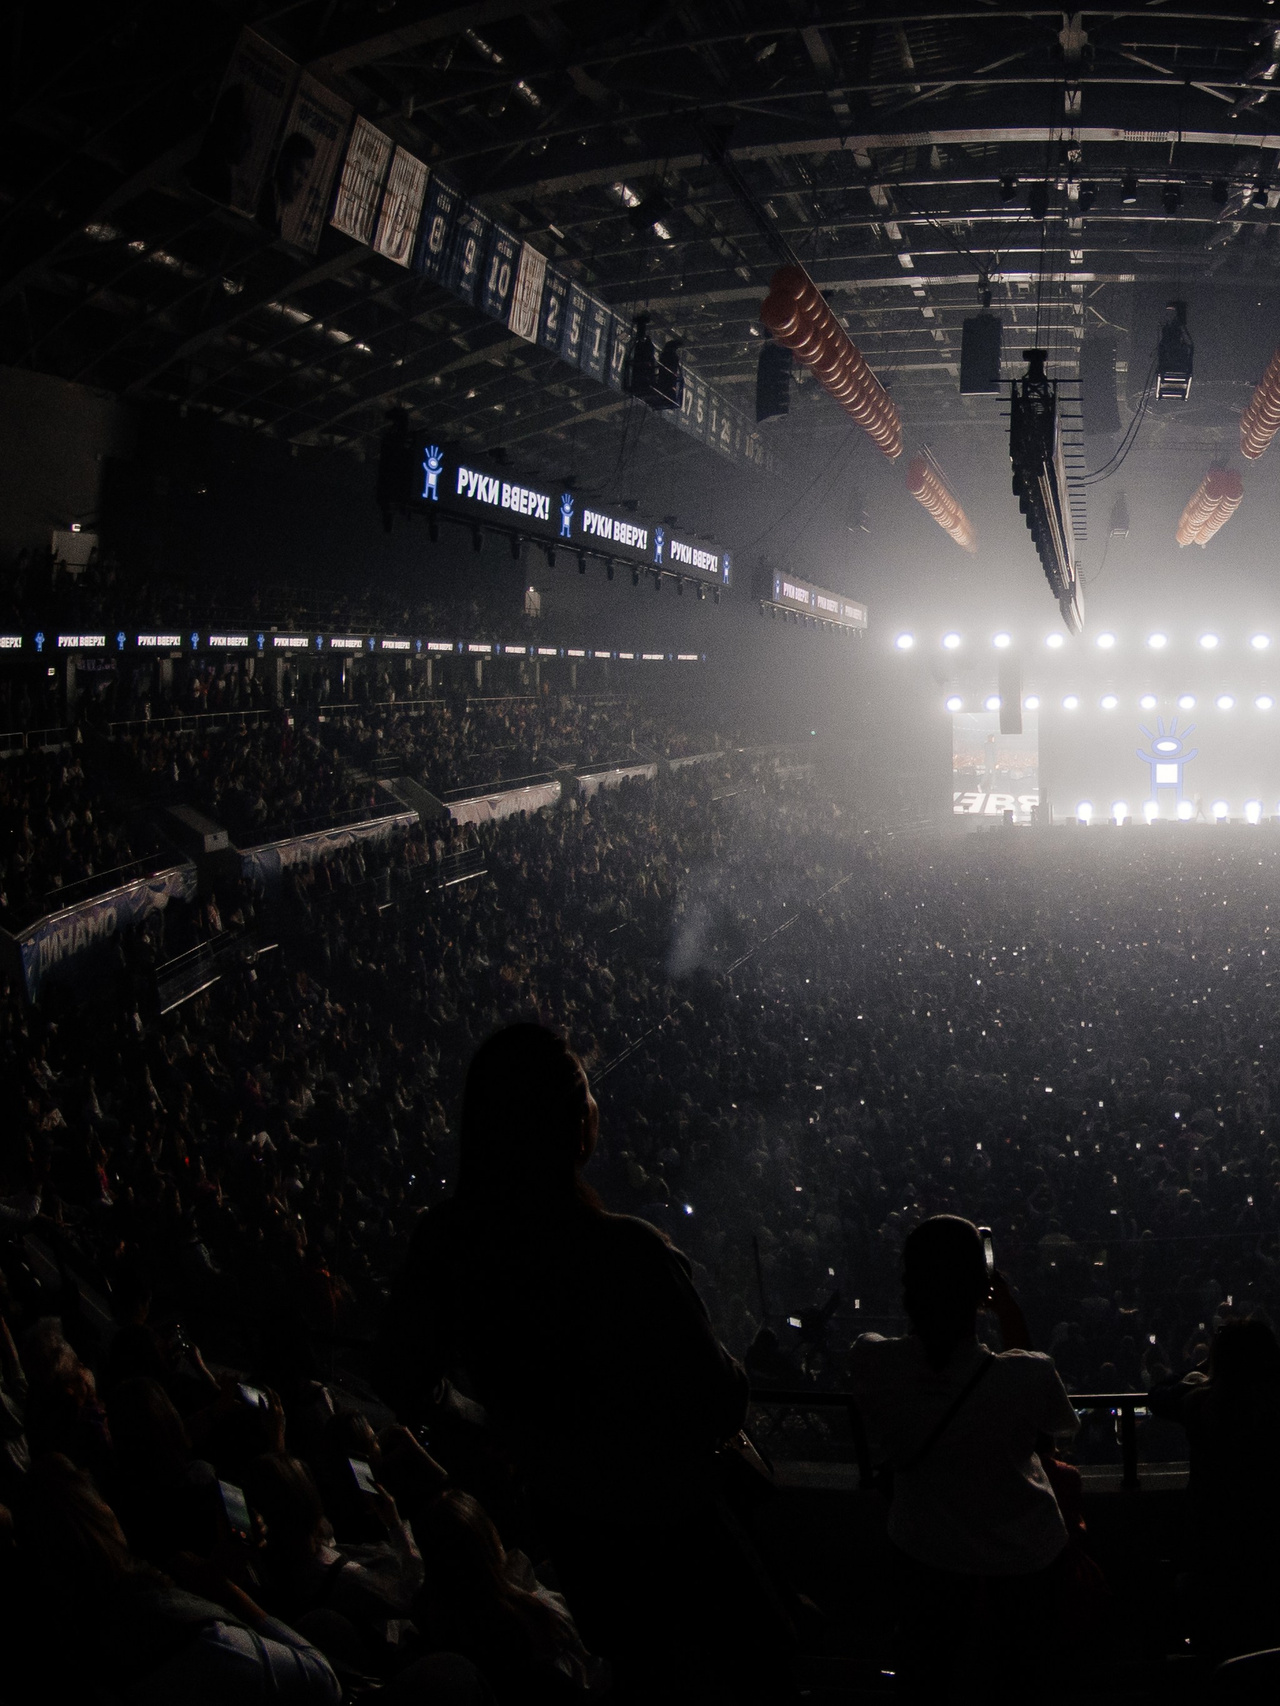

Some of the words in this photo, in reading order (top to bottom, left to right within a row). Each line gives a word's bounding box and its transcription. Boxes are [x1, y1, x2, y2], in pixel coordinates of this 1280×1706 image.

[488, 256, 511, 298] 10
[547, 298, 560, 331] 2
[570, 312, 582, 345] 5
[592, 327, 601, 358] 1
[612, 339, 626, 373] 17
[681, 387, 693, 416] 17
[457, 467, 499, 505] РУКИ
[583, 510, 612, 539] РУКИ
[671, 540, 692, 564] РУКИ
[58, 636, 78, 647] РУКИ
[138, 636, 156, 646] РУКИ
[210, 637, 226, 646] РУКИ
[39, 907, 117, 973] ДИНАМО
